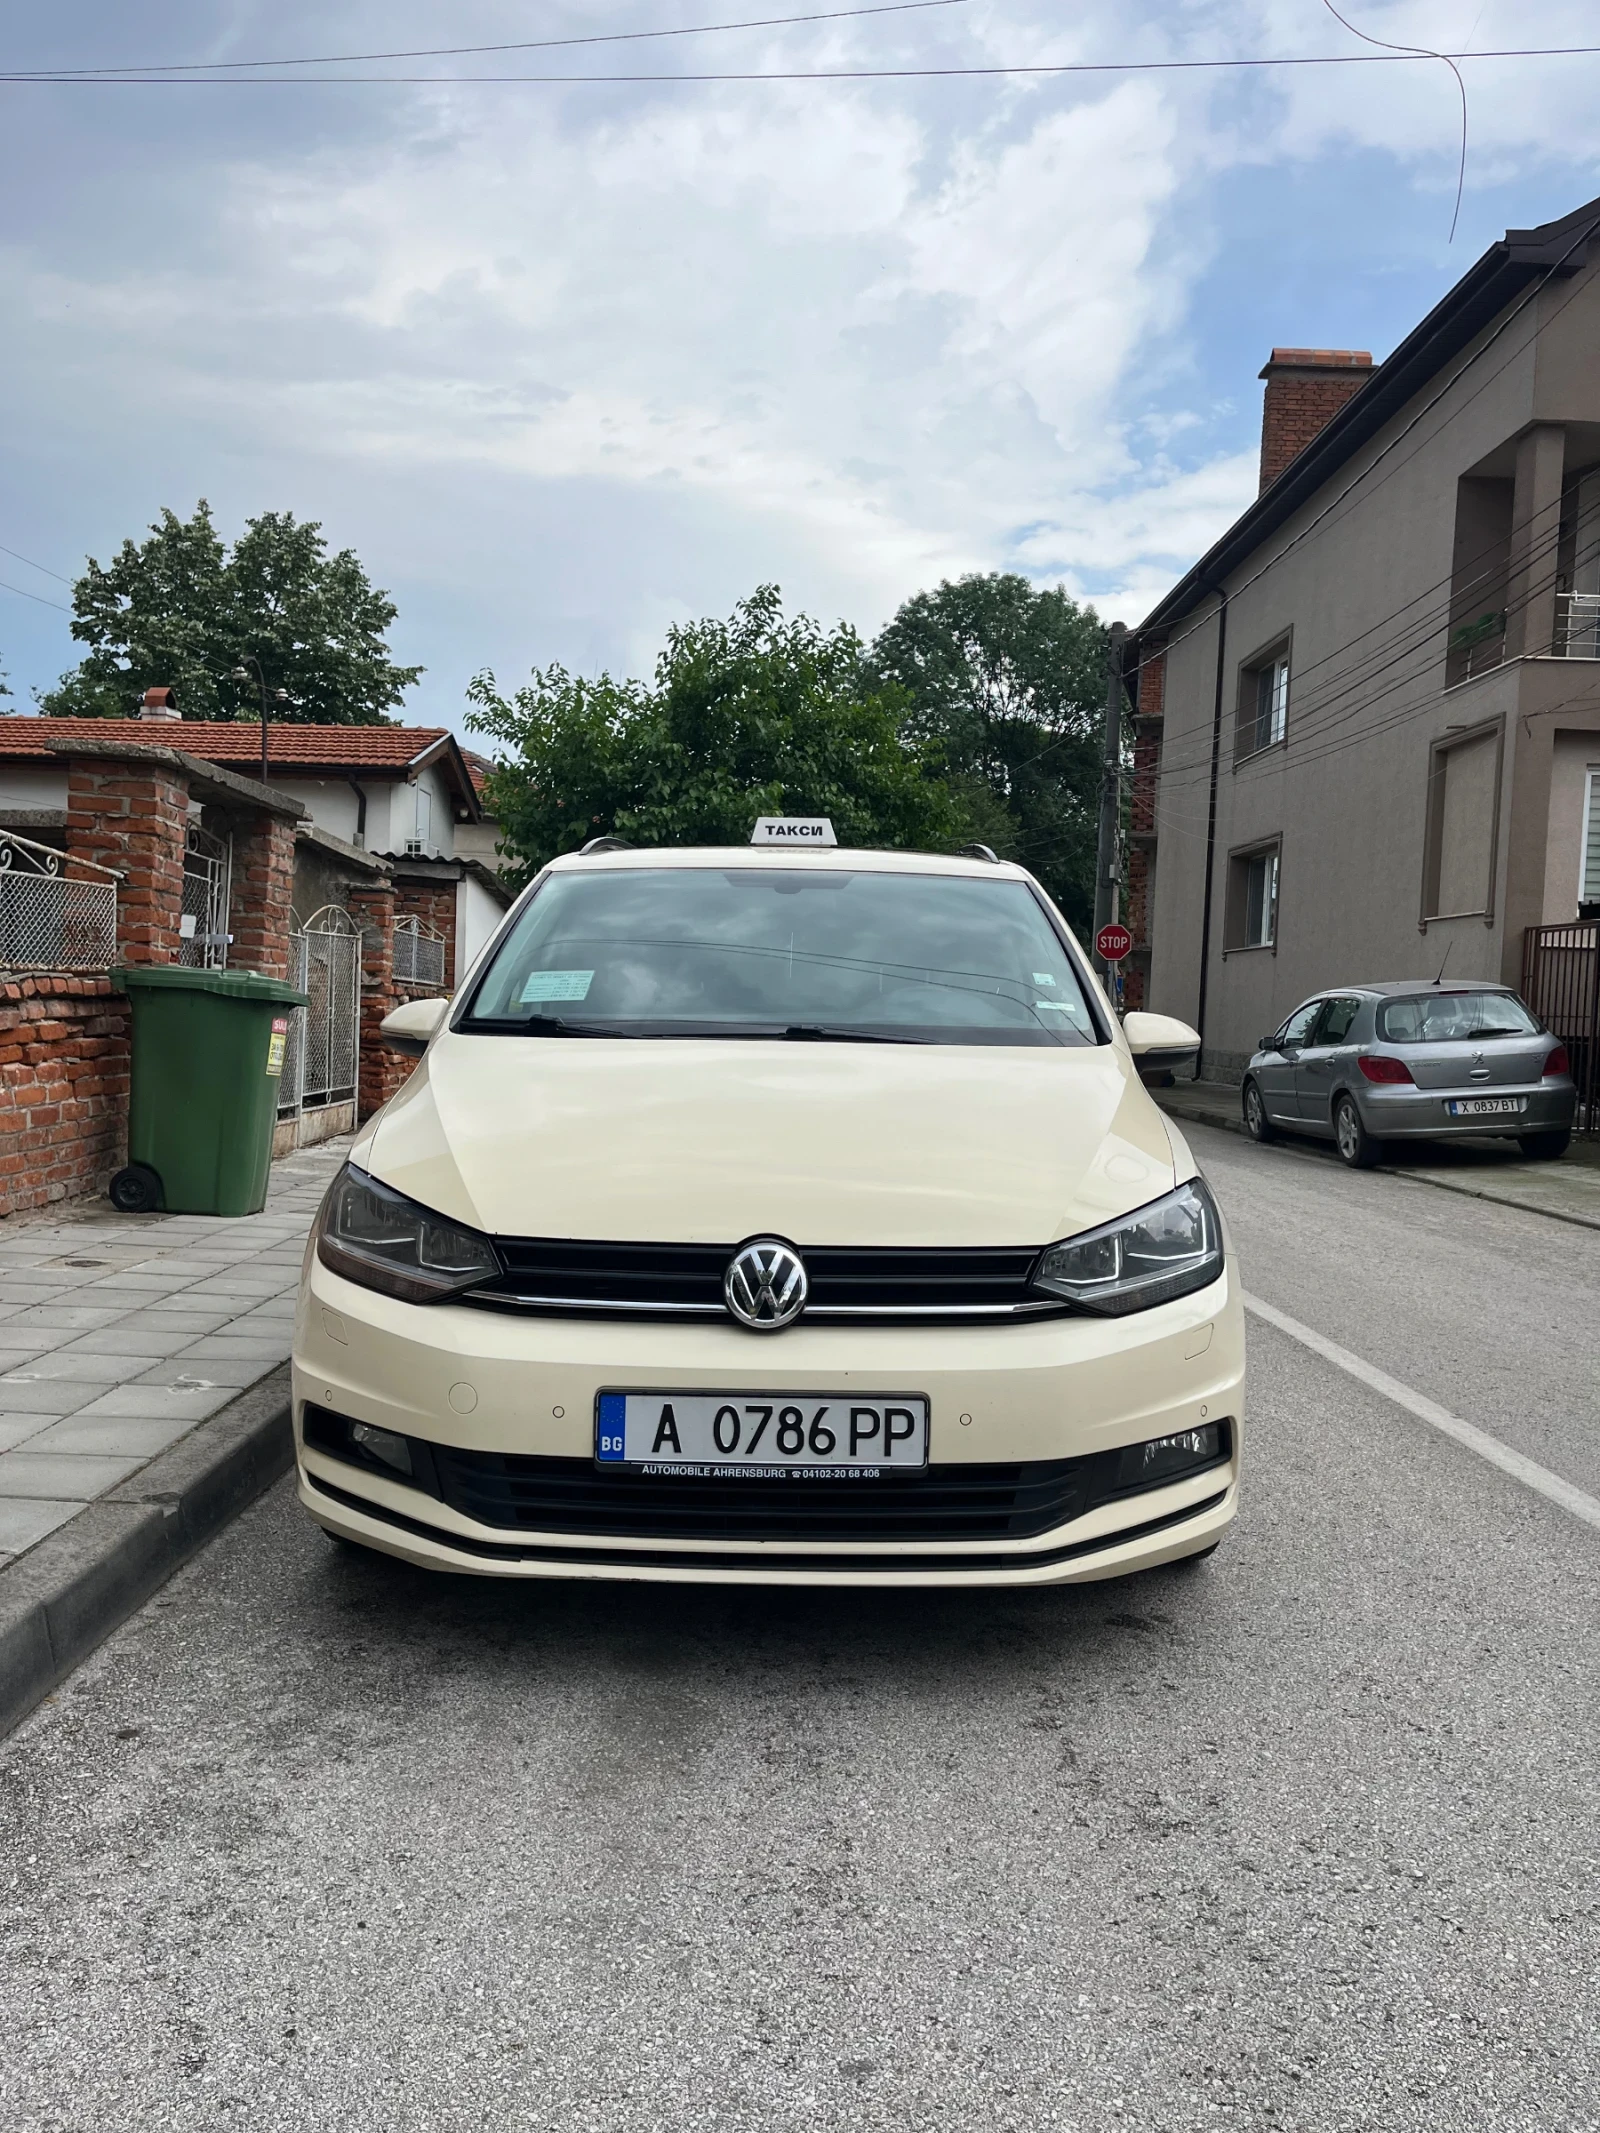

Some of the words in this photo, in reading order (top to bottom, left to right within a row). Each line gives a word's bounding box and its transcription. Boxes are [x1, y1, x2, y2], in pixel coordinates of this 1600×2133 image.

[765, 825, 823, 836] ТАКСИ
[1100, 936, 1128, 949] STOP
[1461, 1102, 1470, 1113] X
[1474, 1101, 1500, 1112] 0837
[1501, 1100, 1516, 1110] BT
[730, 1248, 802, 1323] VW
[651, 1403, 683, 1454] A
[713, 1404, 837, 1455] 0786
[849, 1407, 916, 1457] PP
[601, 1436, 623, 1451] BG
[642, 1465, 711, 1476] AUTOMOBILE
[713, 1467, 787, 1478] AHRENSBURG
[803, 1469, 846, 1478] 04102-20
[848, 1469, 860, 1478] 68
[863, 1469, 880, 1478] 406
